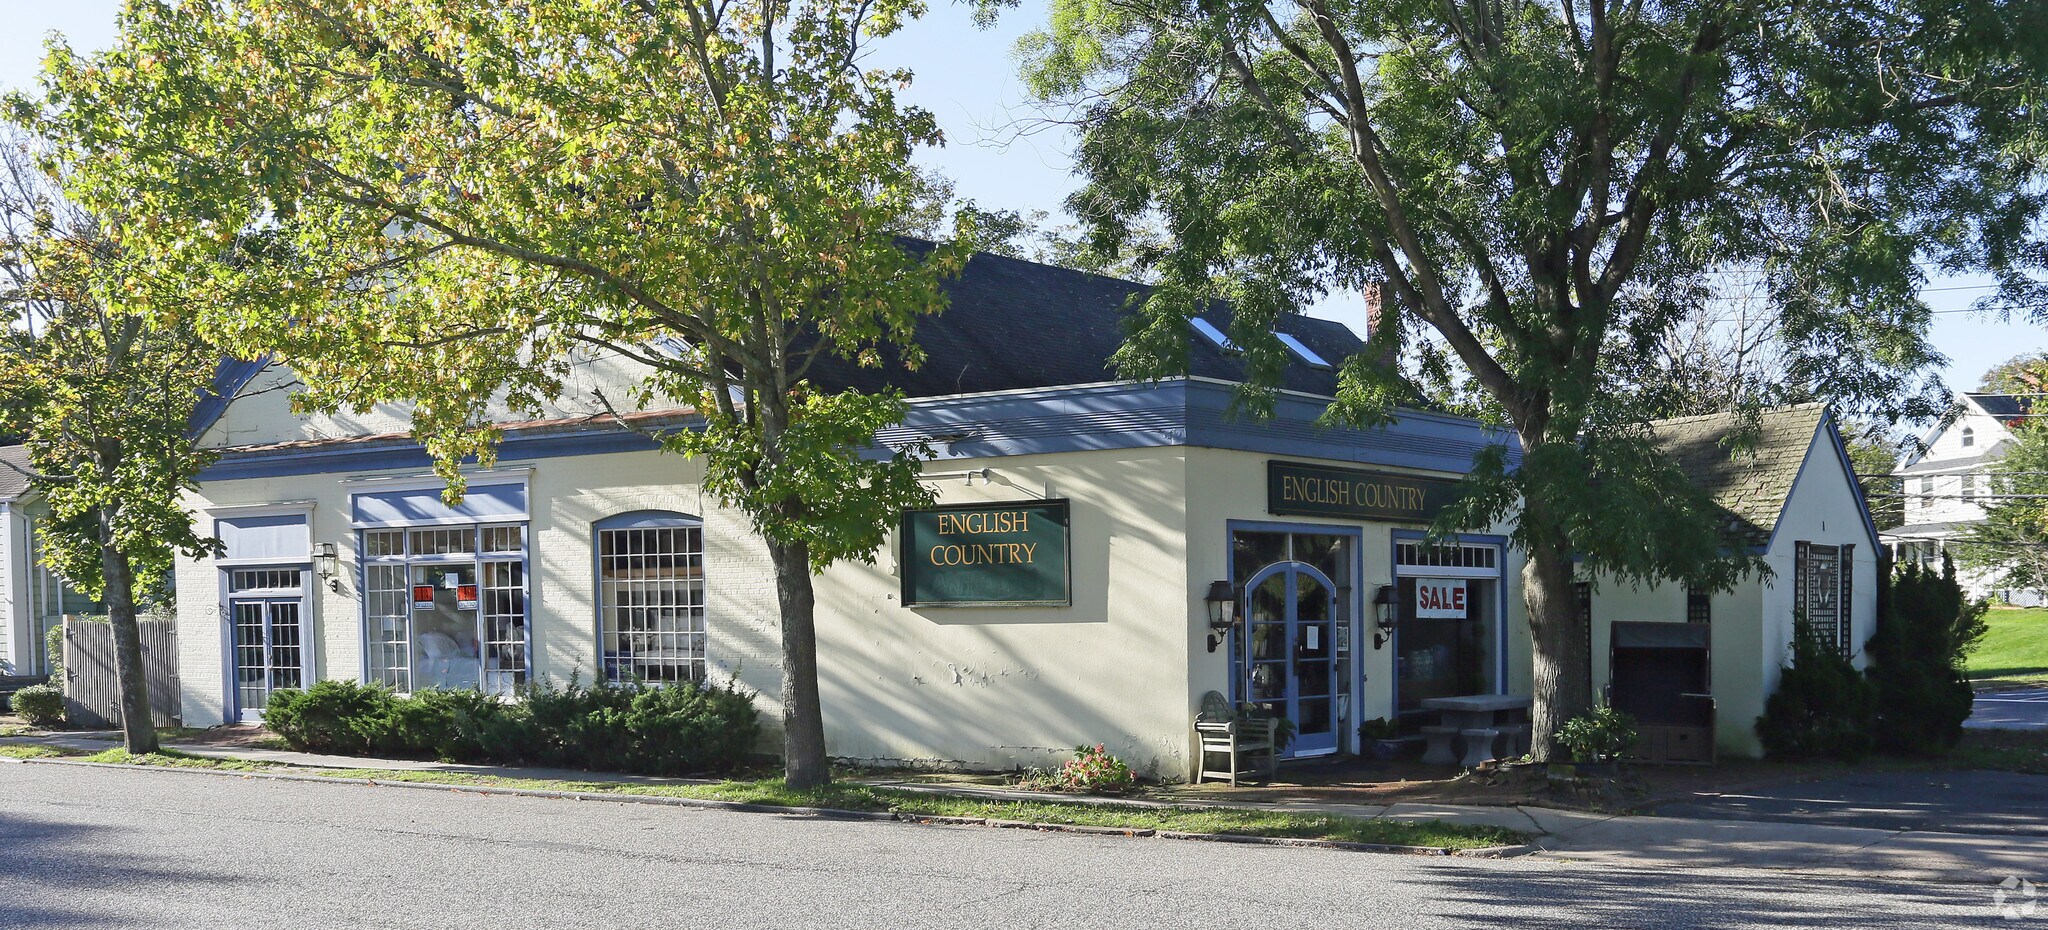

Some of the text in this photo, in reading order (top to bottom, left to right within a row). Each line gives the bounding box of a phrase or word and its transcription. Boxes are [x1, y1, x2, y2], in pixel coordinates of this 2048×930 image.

[1283, 475, 1427, 511] ENGLISH COUNTRY
[938, 511, 1029, 535] ENGLISH
[930, 542, 1037, 566] COUNTRY
[1419, 585, 1465, 610] SALE
